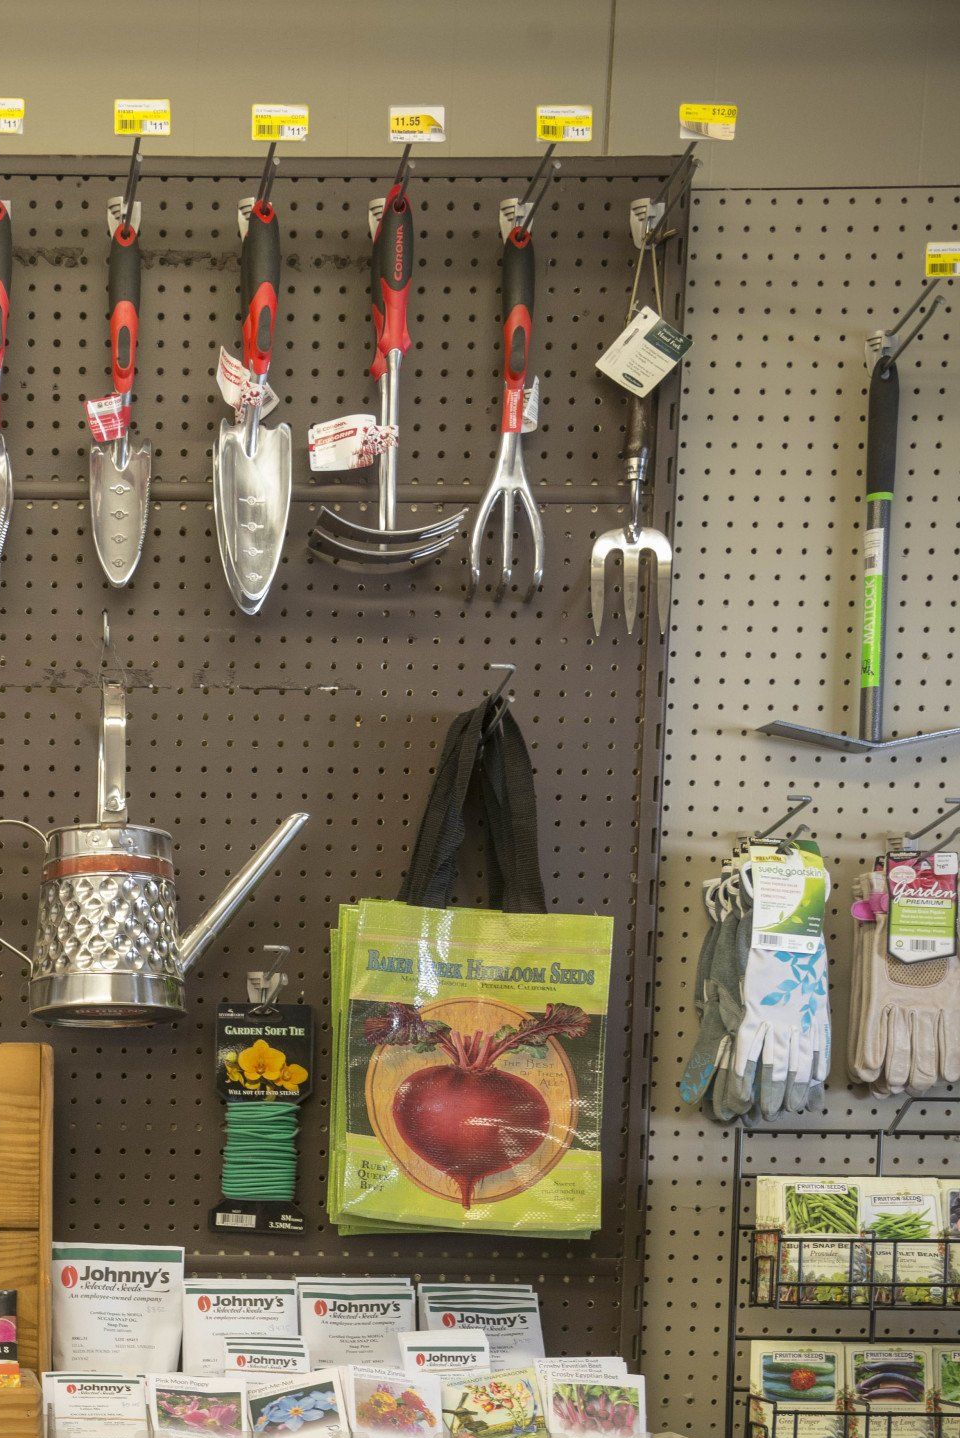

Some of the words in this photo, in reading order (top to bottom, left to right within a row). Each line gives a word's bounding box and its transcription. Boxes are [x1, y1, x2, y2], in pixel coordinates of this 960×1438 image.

[395, 117, 420, 126] 11.55
[393, 225, 405, 282] CORONA
[758, 866, 783, 874] suede
[785, 867, 822, 877] goatskin
[893, 880, 956, 903] Garden
[367, 950, 413, 974] BAKER
[466, 958, 546, 984] HEIRLOOM
[549, 963, 595, 985] SEEDS
[225, 1026, 263, 1036] GARDEN
[265, 1026, 287, 1036] SOFT
[289, 1026, 305, 1036] TIE
[80, 1265, 170, 1288] Johnny's
[212, 1295, 284, 1308] Johnny's
[329, 1301, 400, 1315] Johnny's
[800, 1352, 824, 1360] SEEDS
[573, 1373, 600, 1381] Egyptian
[248, 1380, 293, 1395] Forget-Me-Not
